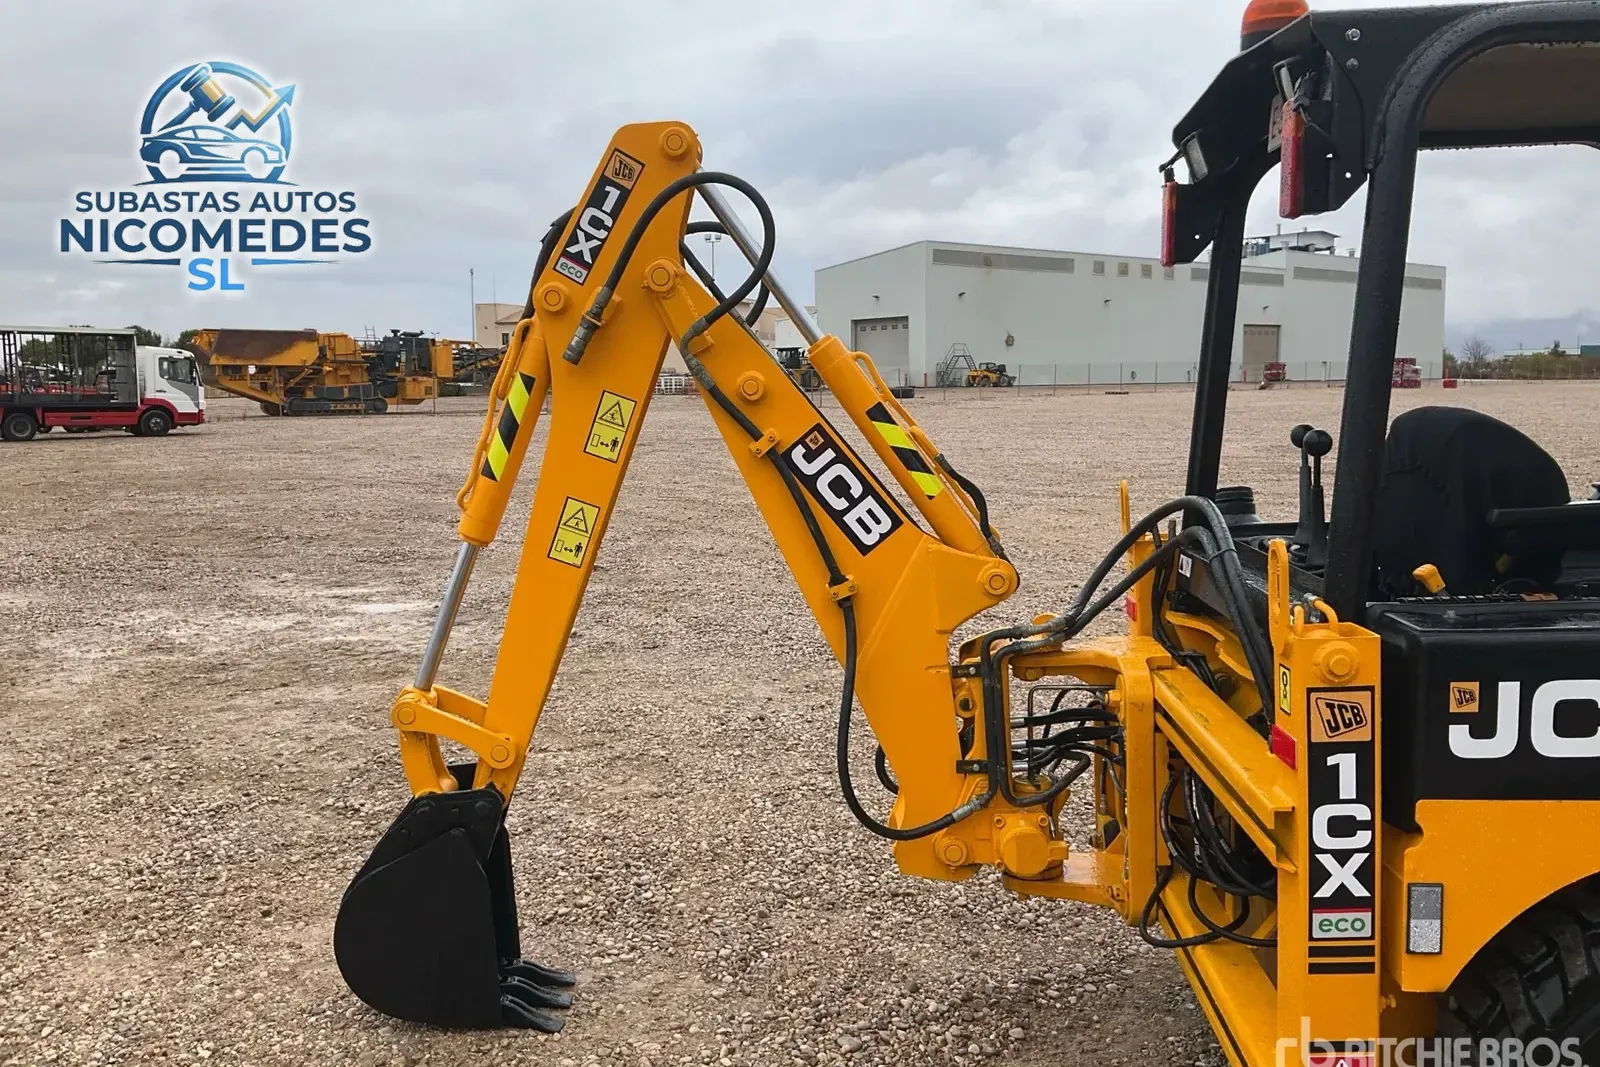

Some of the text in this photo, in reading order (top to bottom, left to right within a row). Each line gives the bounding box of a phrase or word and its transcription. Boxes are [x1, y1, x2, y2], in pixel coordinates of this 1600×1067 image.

[613, 158, 634, 180] JCB
[566, 185, 621, 264] 1CX
[559, 261, 583, 279] eco
[791, 443, 893, 546] JCB
[1457, 688, 1475, 706] JCB
[1325, 700, 1364, 734] JCB
[1448, 680, 1600, 759] JC
[1312, 752, 1372, 898] 1CX
[1318, 916, 1366, 933] eco
